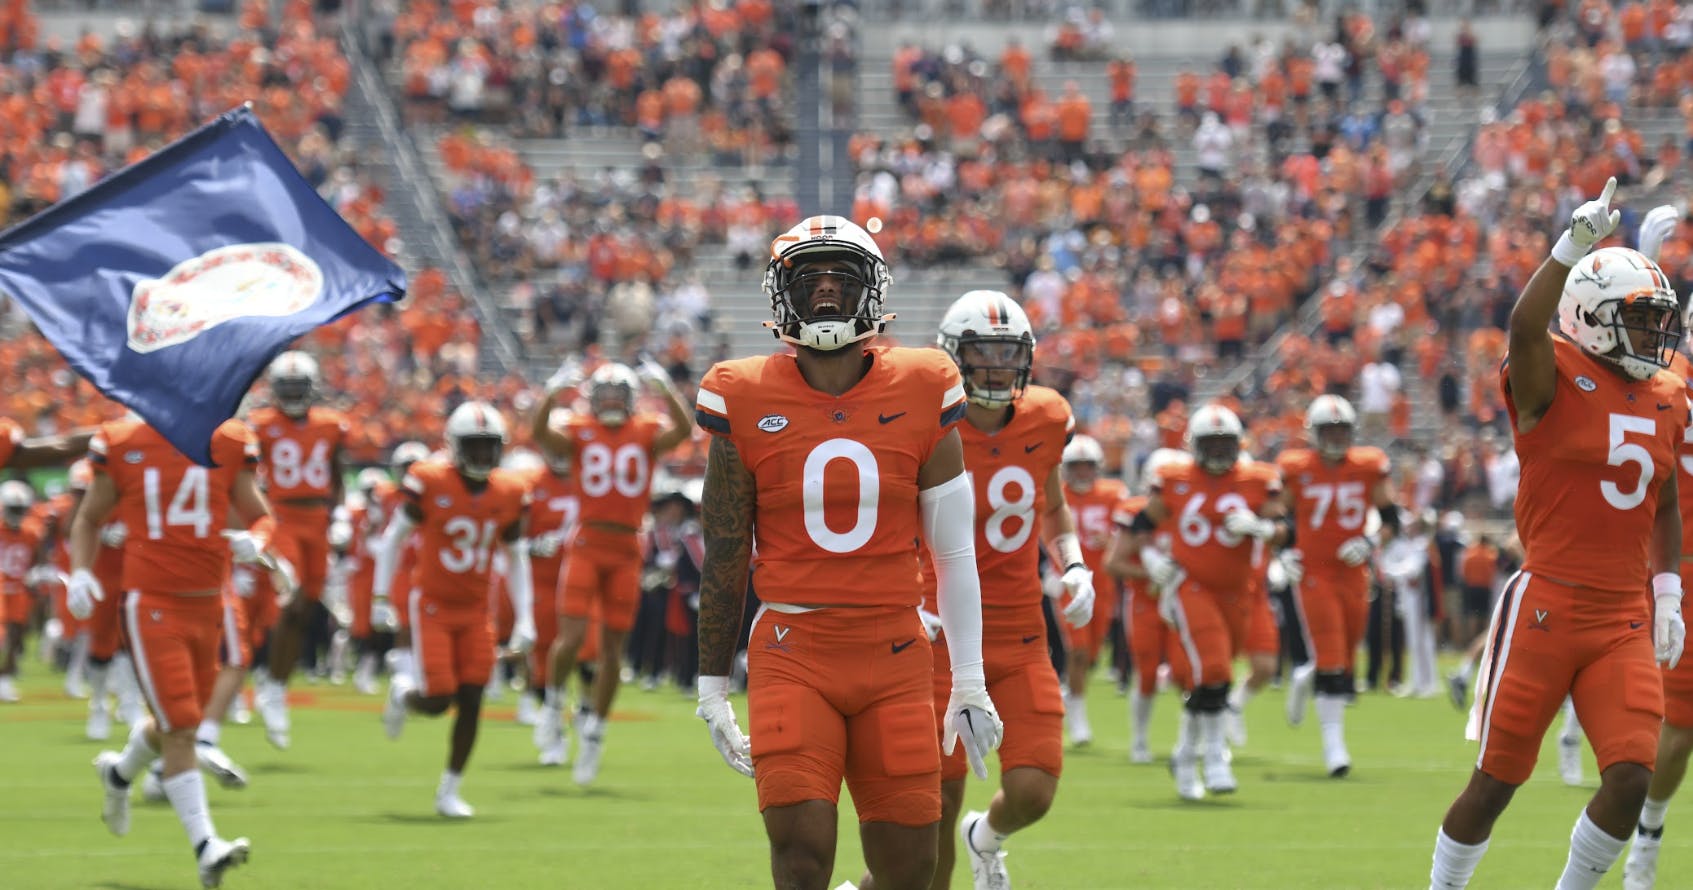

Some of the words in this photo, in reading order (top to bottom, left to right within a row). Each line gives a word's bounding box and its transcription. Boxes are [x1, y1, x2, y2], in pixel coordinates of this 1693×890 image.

[761, 417, 784, 427] ACC
[272, 439, 331, 488] 86
[581, 444, 647, 496] 80
[1600, 413, 1656, 510] 5
[144, 466, 212, 539] 14
[803, 438, 880, 553] 0
[1305, 483, 1365, 529] 75
[440, 518, 496, 572] 31
